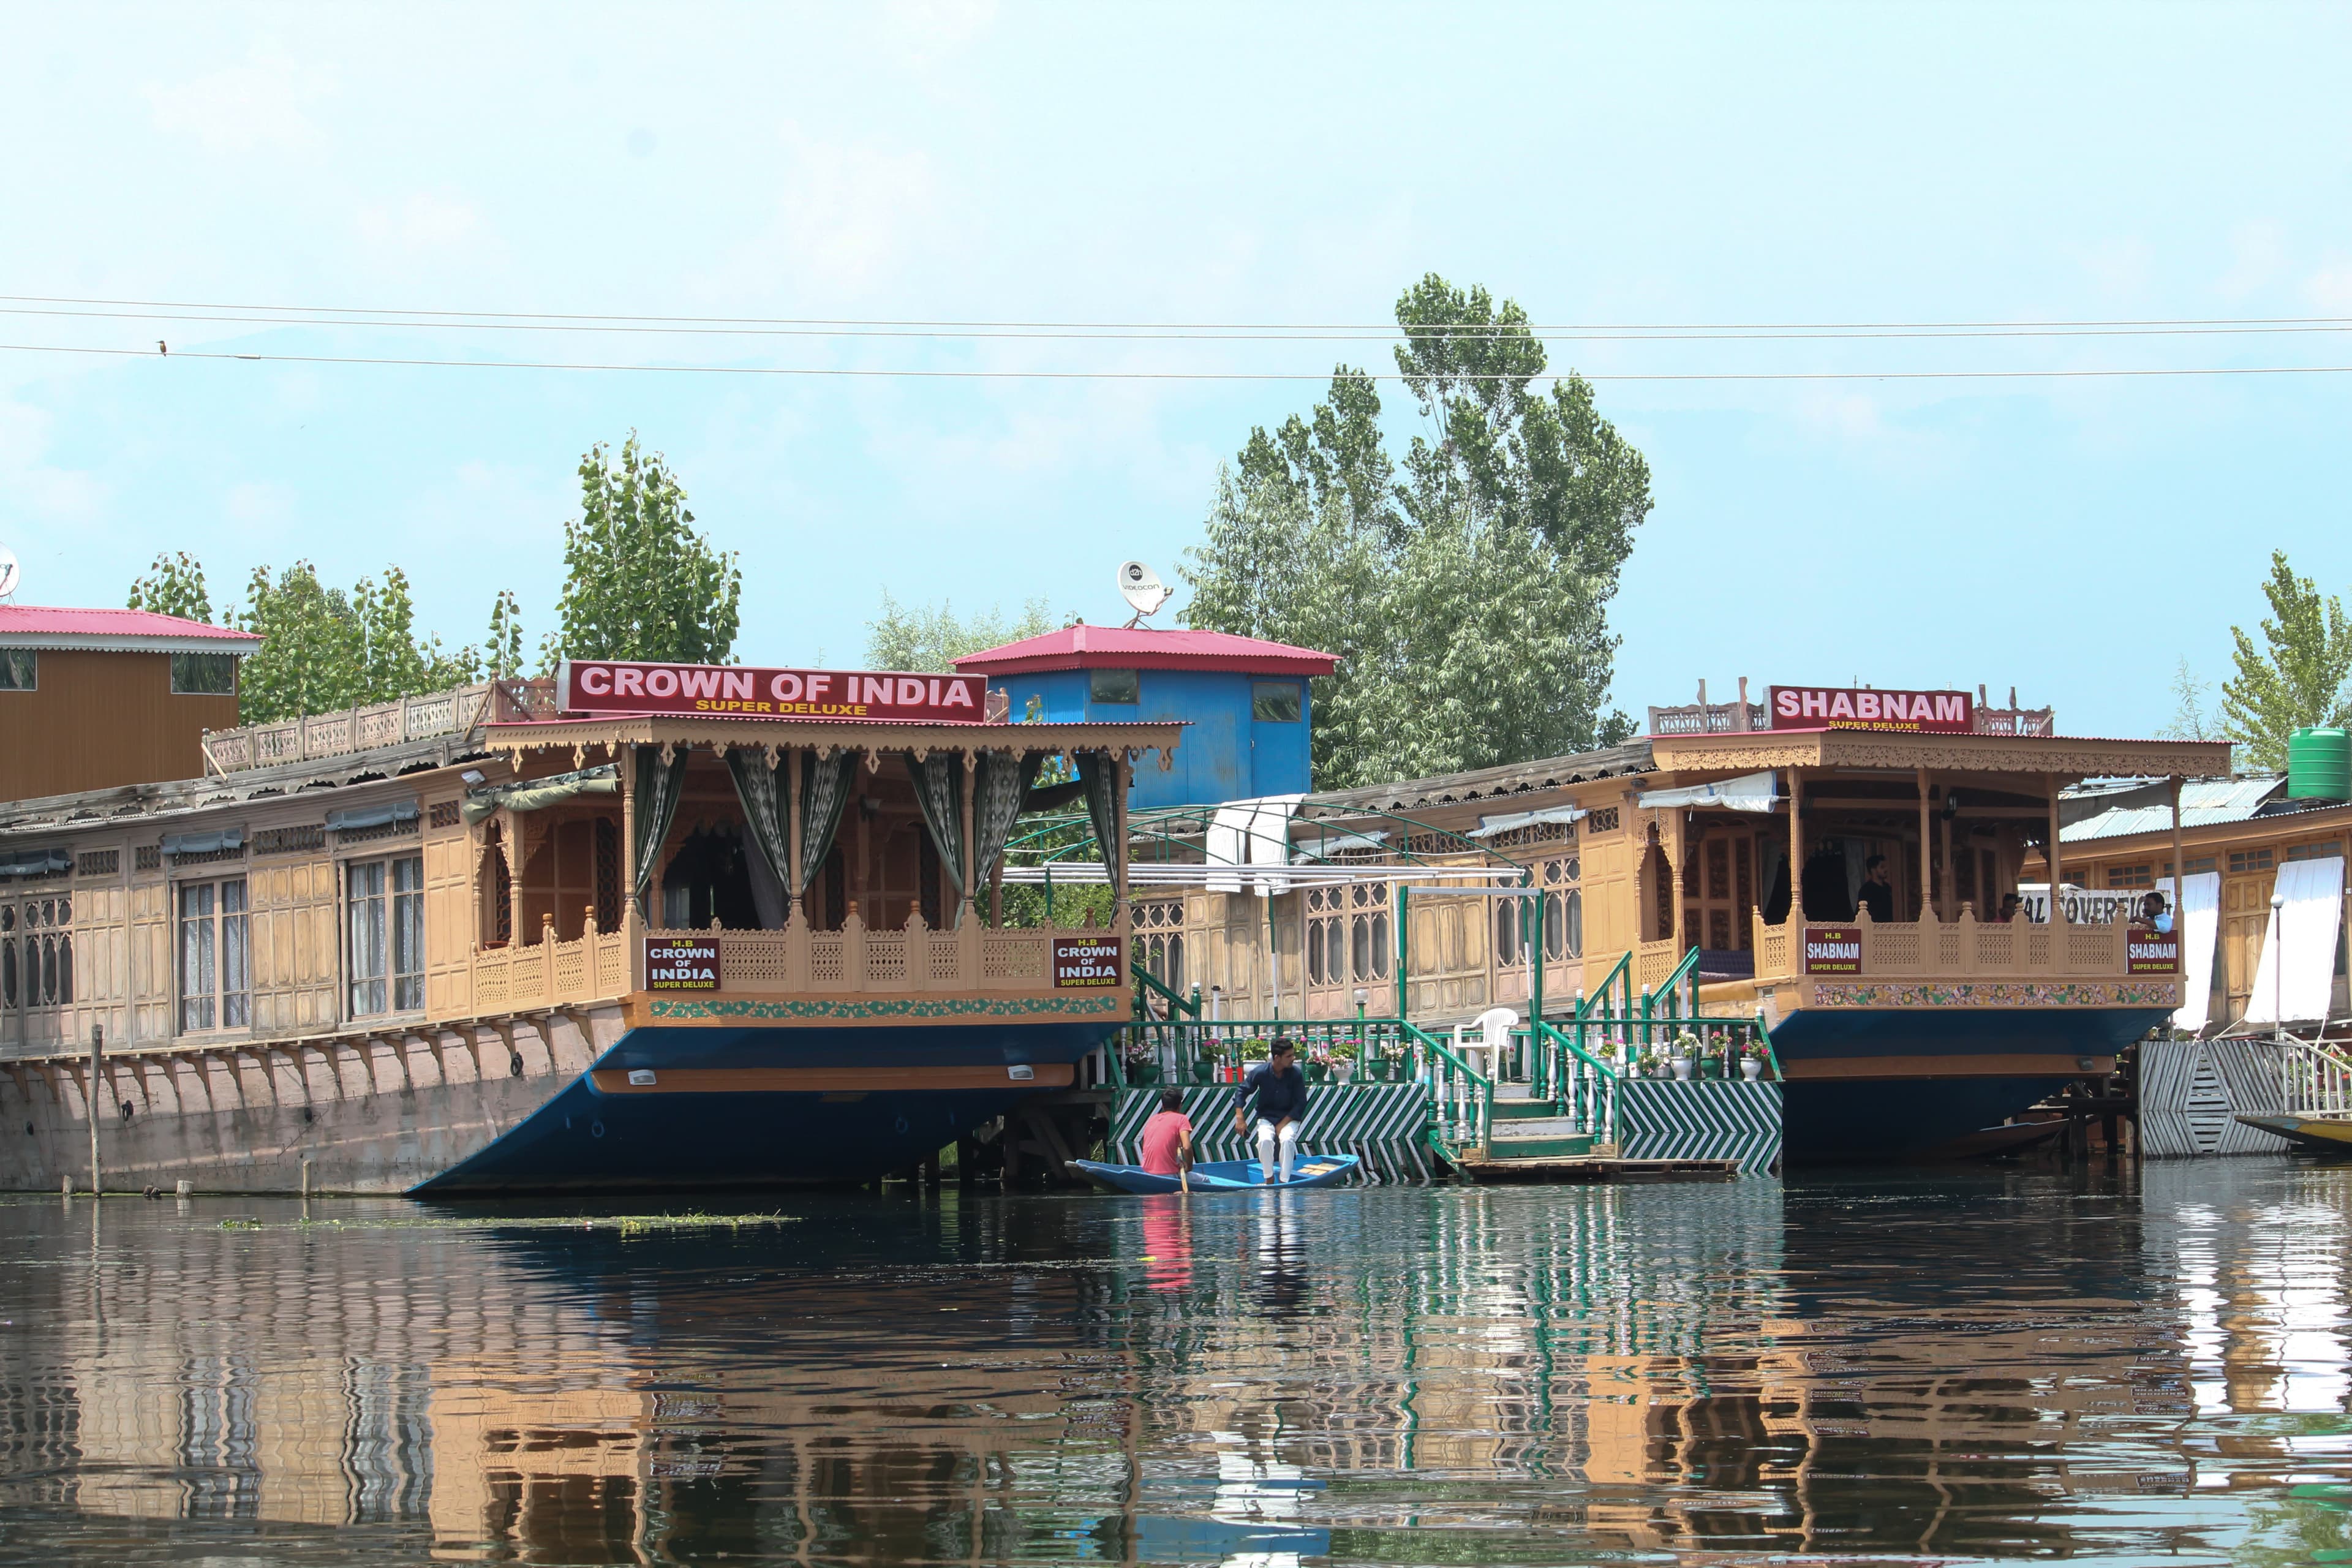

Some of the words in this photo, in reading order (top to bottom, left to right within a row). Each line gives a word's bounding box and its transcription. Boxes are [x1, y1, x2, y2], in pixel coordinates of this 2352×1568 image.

[581, 667, 755, 699] CROWN
[771, 674, 831, 701] OF
[848, 676, 974, 707] INDIA
[696, 700, 771, 712] SUPER
[779, 703, 867, 715] DELUXE
[1777, 690, 1964, 722] SHABNAM
[2019, 895, 2046, 923] AL
[650, 948, 715, 959] CROWN
[1058, 946, 1117, 957] CROWN
[1807, 943, 1859, 959] SHABNAM
[2129, 943, 2176, 959] SHABNAM
[652, 968, 715, 979] INDIA
[1060, 966, 1117, 978] INDIA
